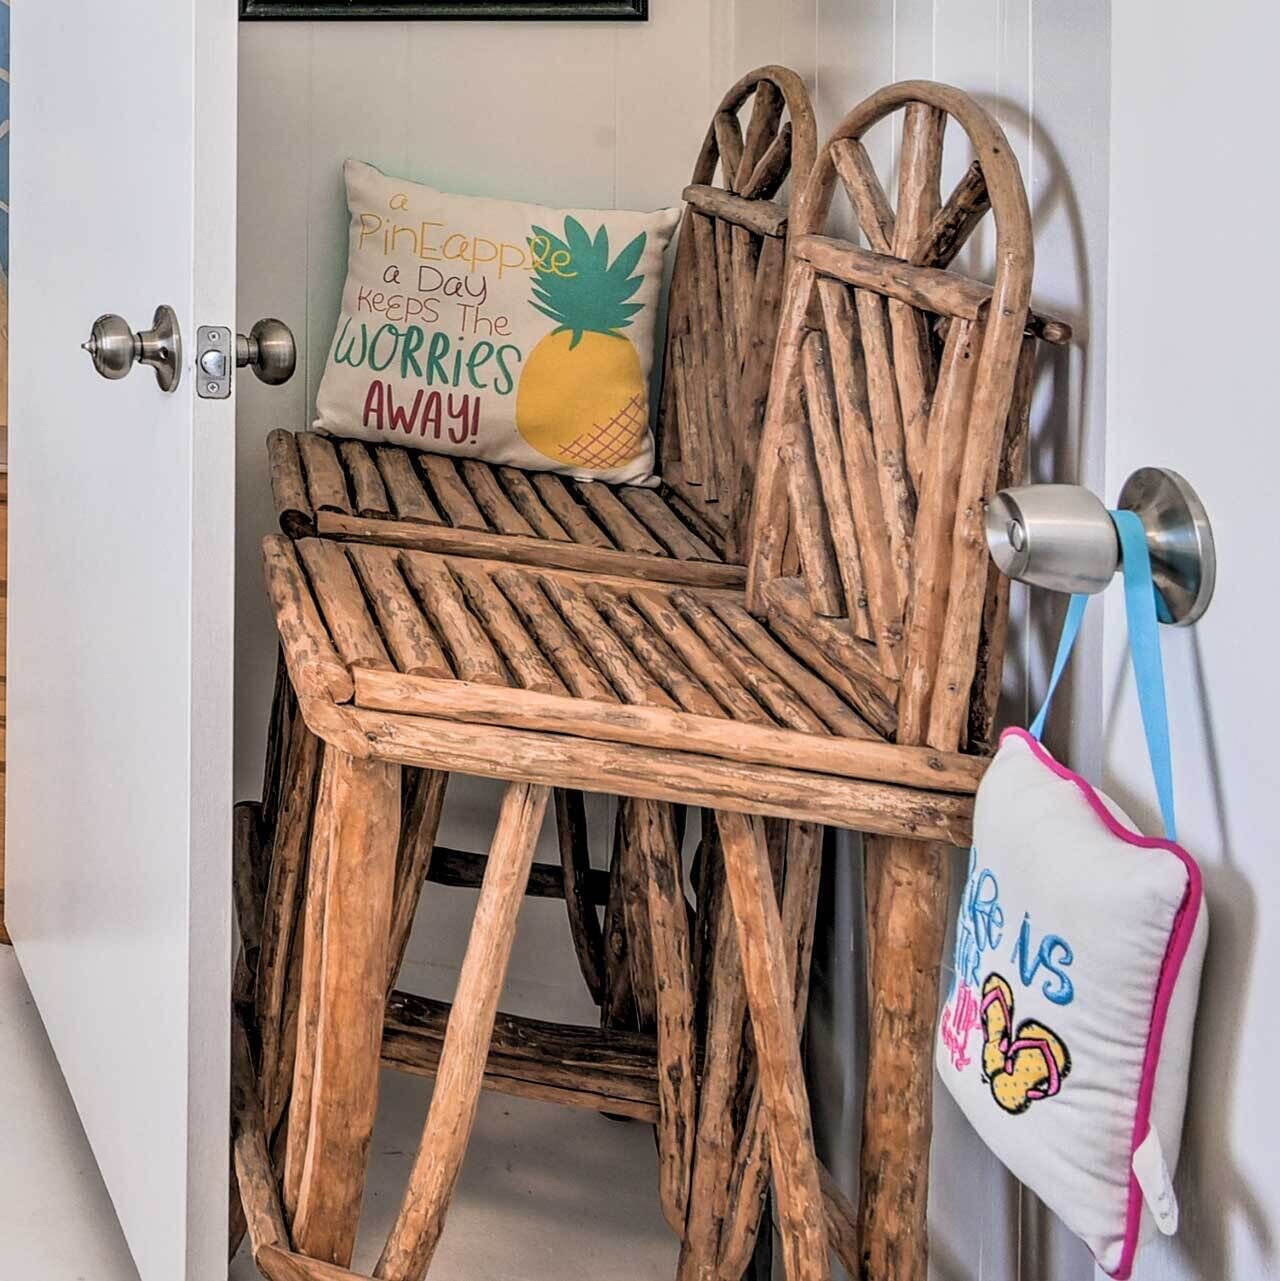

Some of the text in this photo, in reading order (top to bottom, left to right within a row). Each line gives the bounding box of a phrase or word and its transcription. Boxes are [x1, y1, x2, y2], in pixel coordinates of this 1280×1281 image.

[388, 193, 409, 211] a
[383, 265, 400, 284] a
[456, 303, 513, 336] The
[1011, 912, 1074, 1007] is
